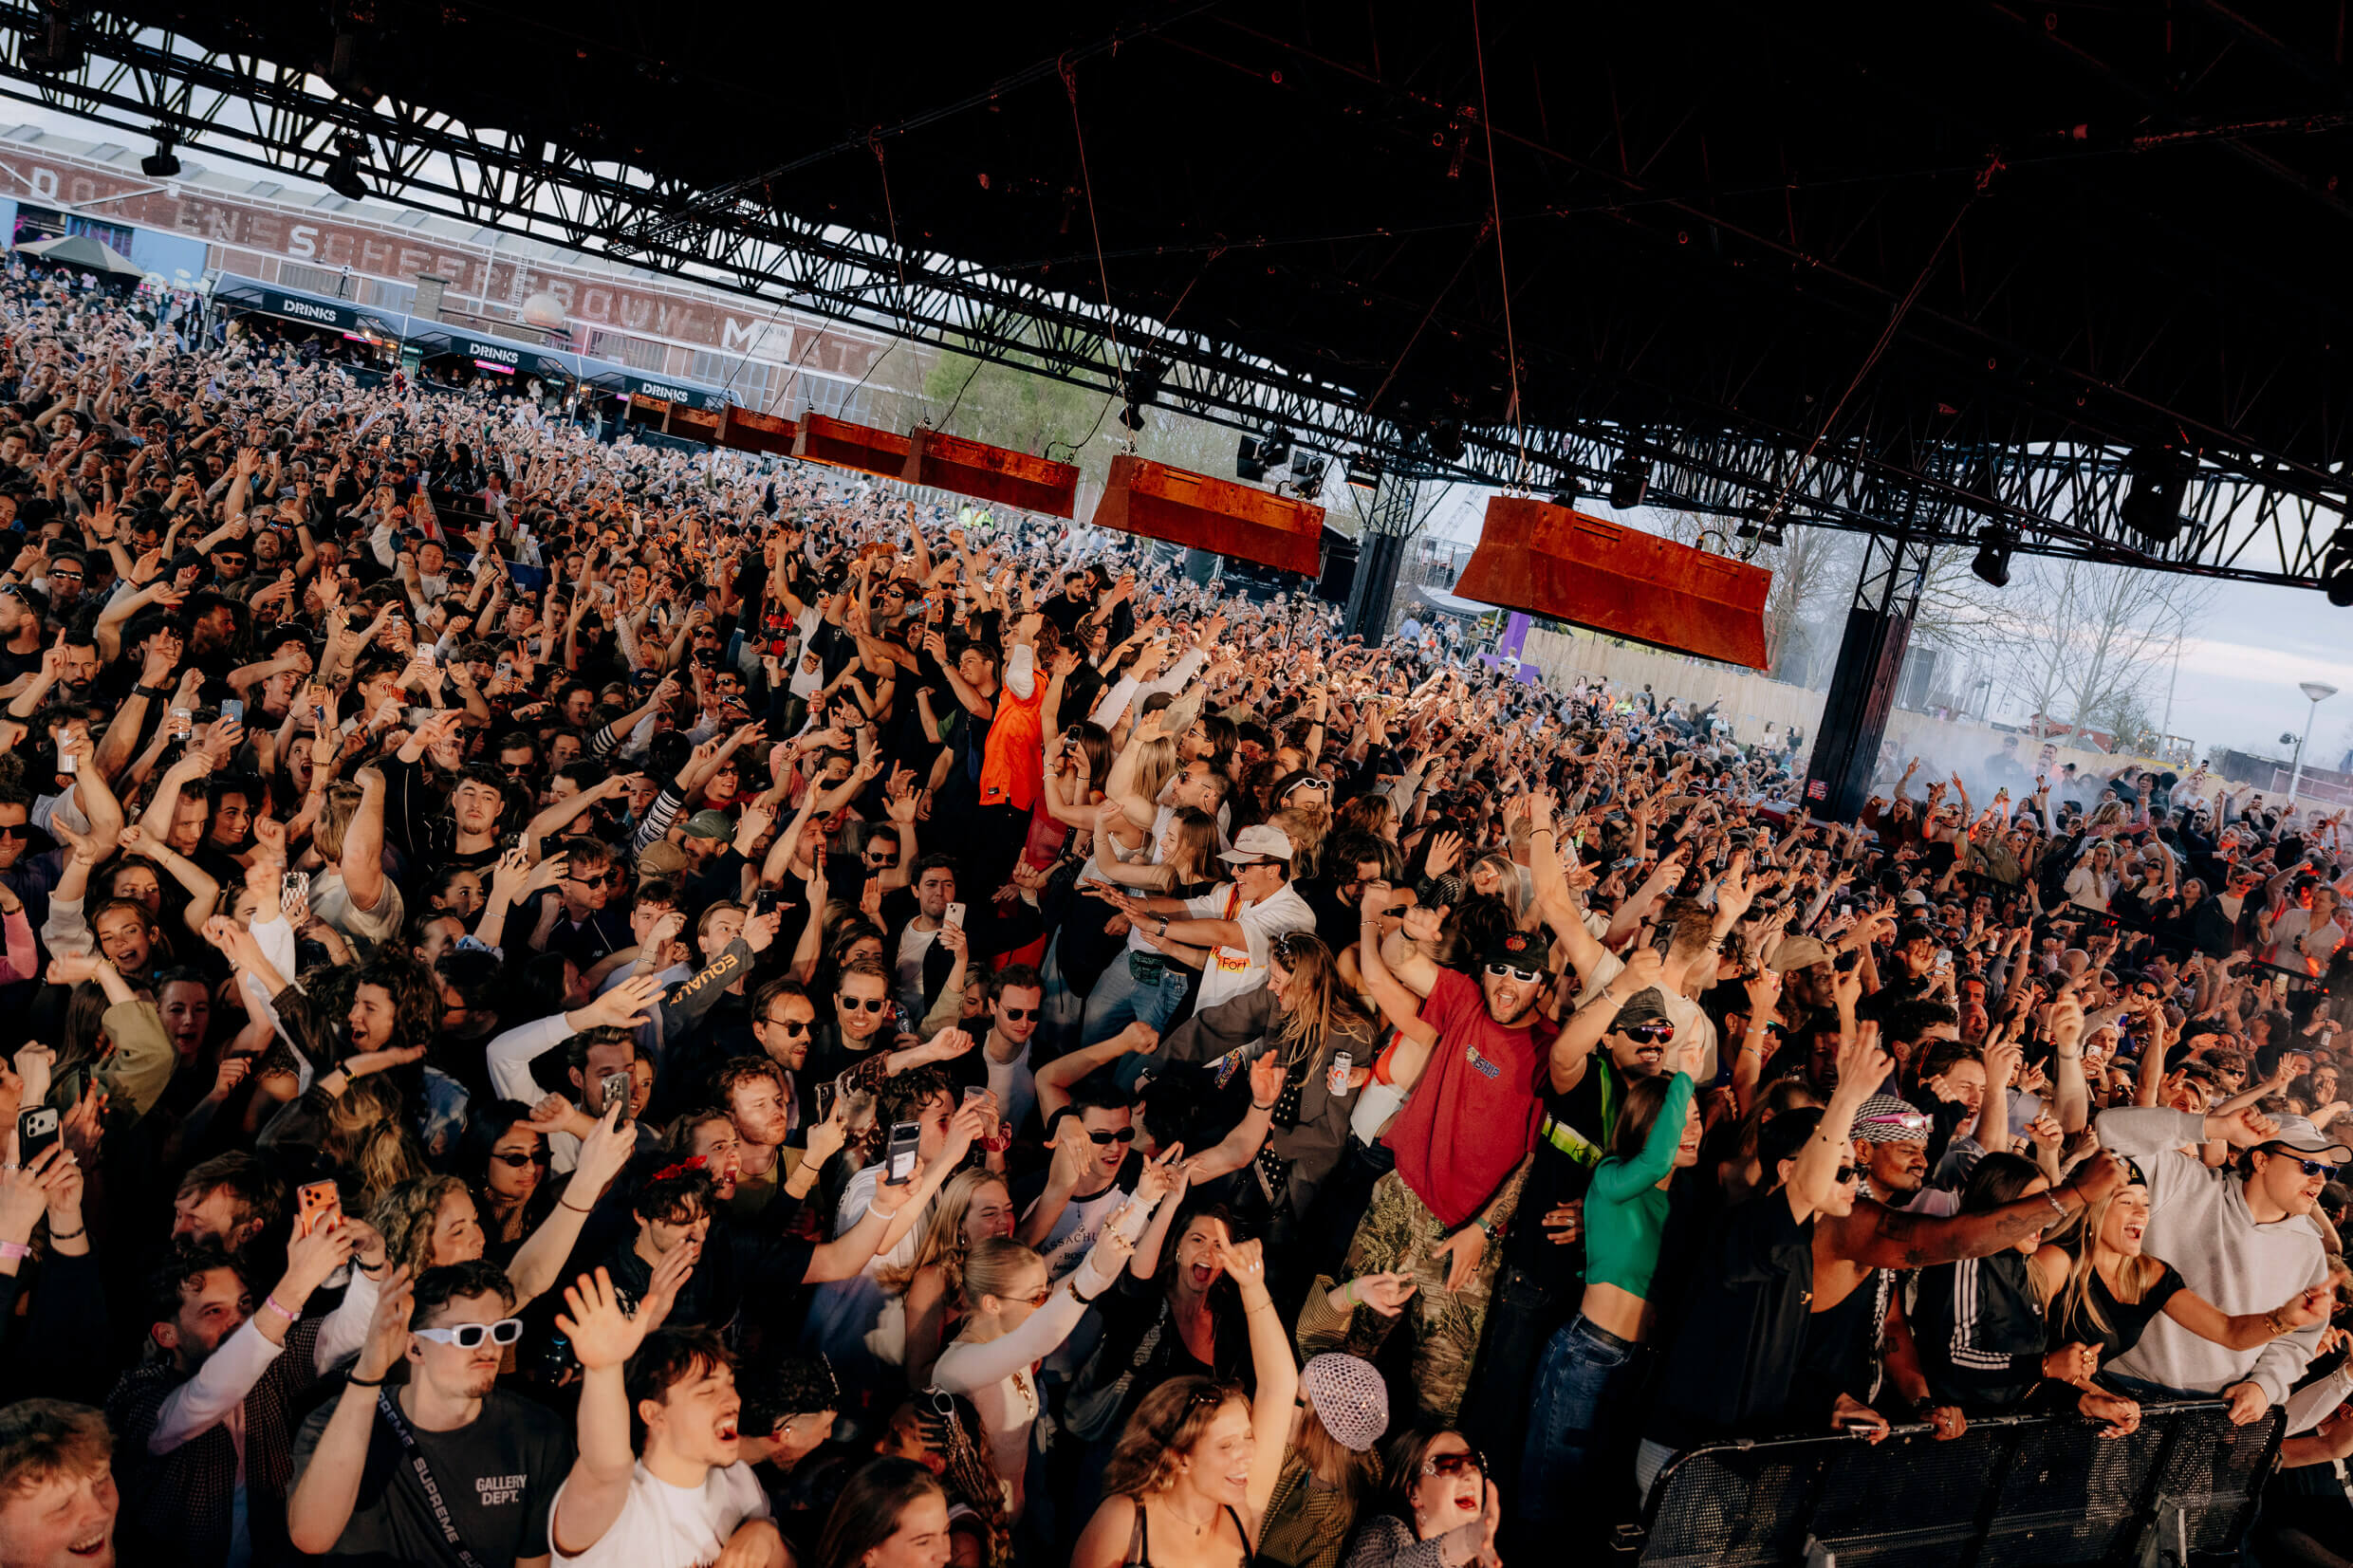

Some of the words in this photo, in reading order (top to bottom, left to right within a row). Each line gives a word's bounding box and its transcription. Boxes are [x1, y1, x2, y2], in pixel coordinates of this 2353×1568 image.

[284, 299, 337, 322] DRINKS
[470, 342, 519, 363] DRINKS
[641, 382, 689, 403] DRINKS
[1042, 1232, 1098, 1255] ASSACHU
[475, 1474, 528, 1493] GALLERY
[413, 1456, 460, 1544] SUPREME
[481, 1489, 520, 1506] DEPT.
